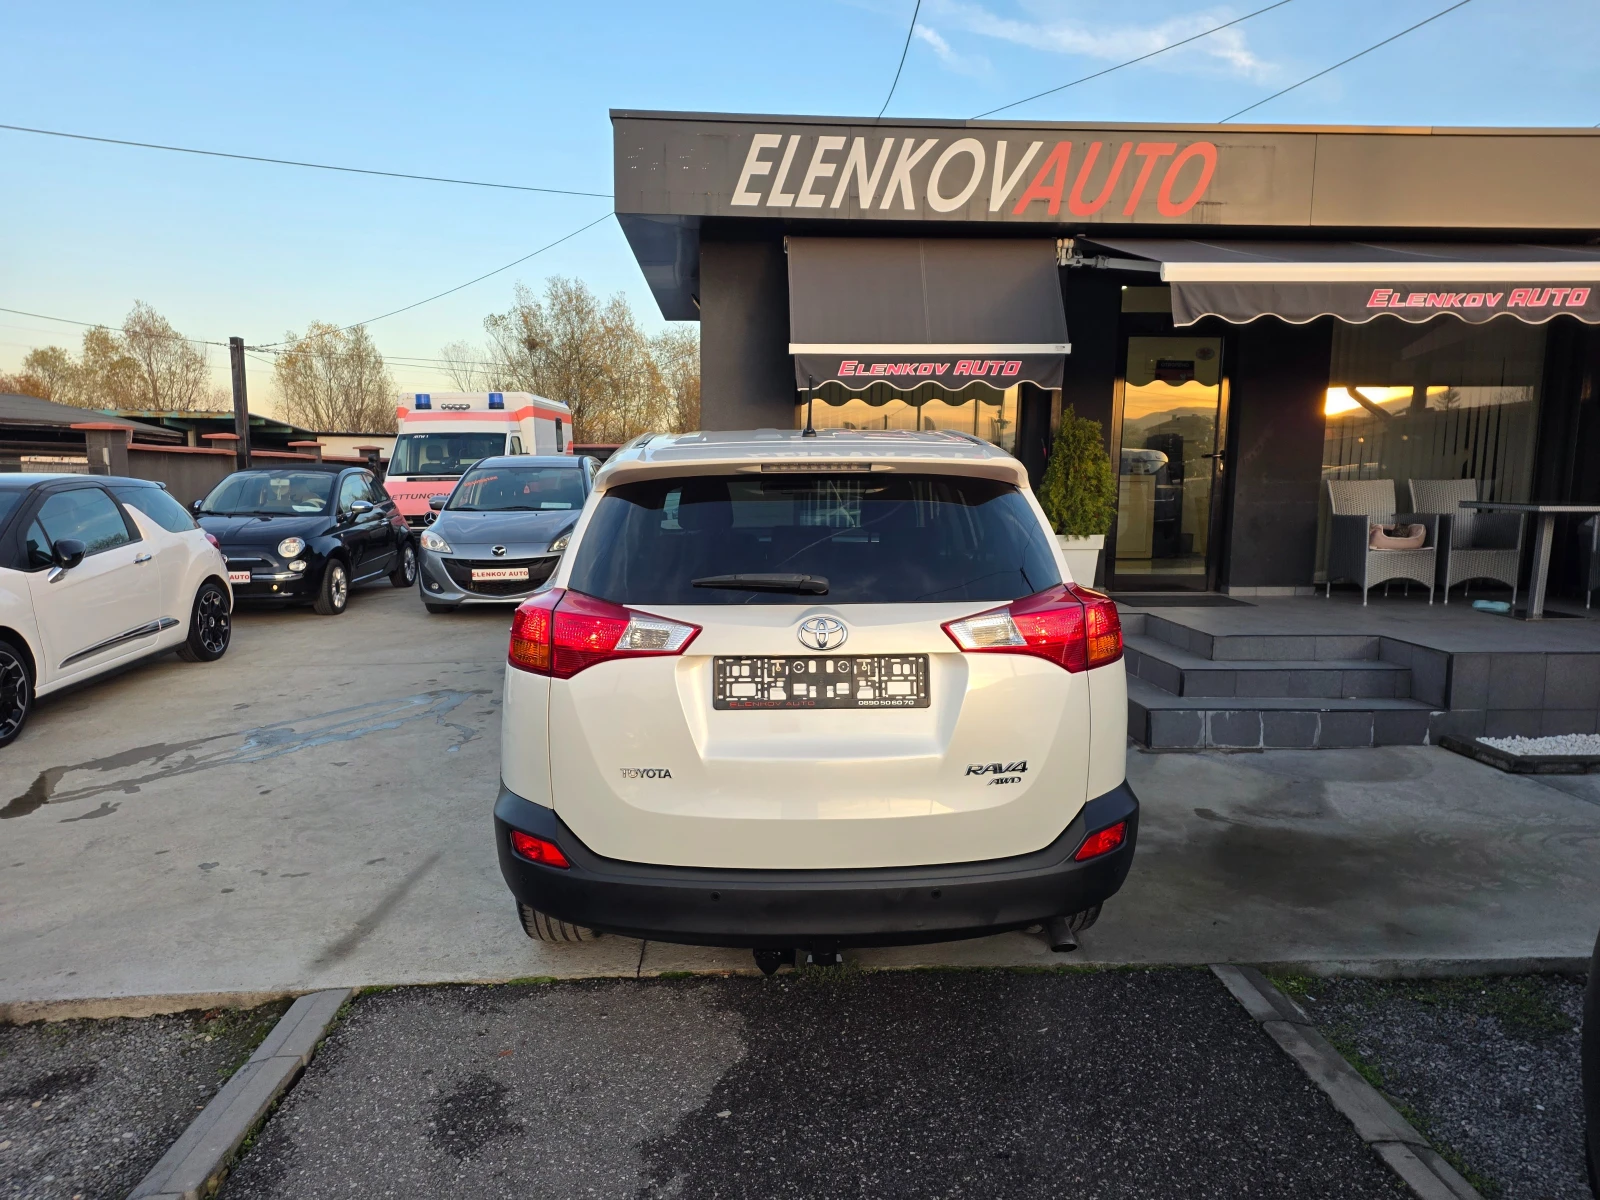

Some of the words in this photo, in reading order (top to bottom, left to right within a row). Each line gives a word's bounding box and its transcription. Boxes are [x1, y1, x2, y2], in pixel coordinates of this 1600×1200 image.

[1507, 288, 1591, 307] AUTO
[952, 359, 1023, 376] AUTO
[619, 768, 673, 779] TOYOTA
[964, 760, 1028, 776] RAV4
[987, 776, 1022, 786] AWD
